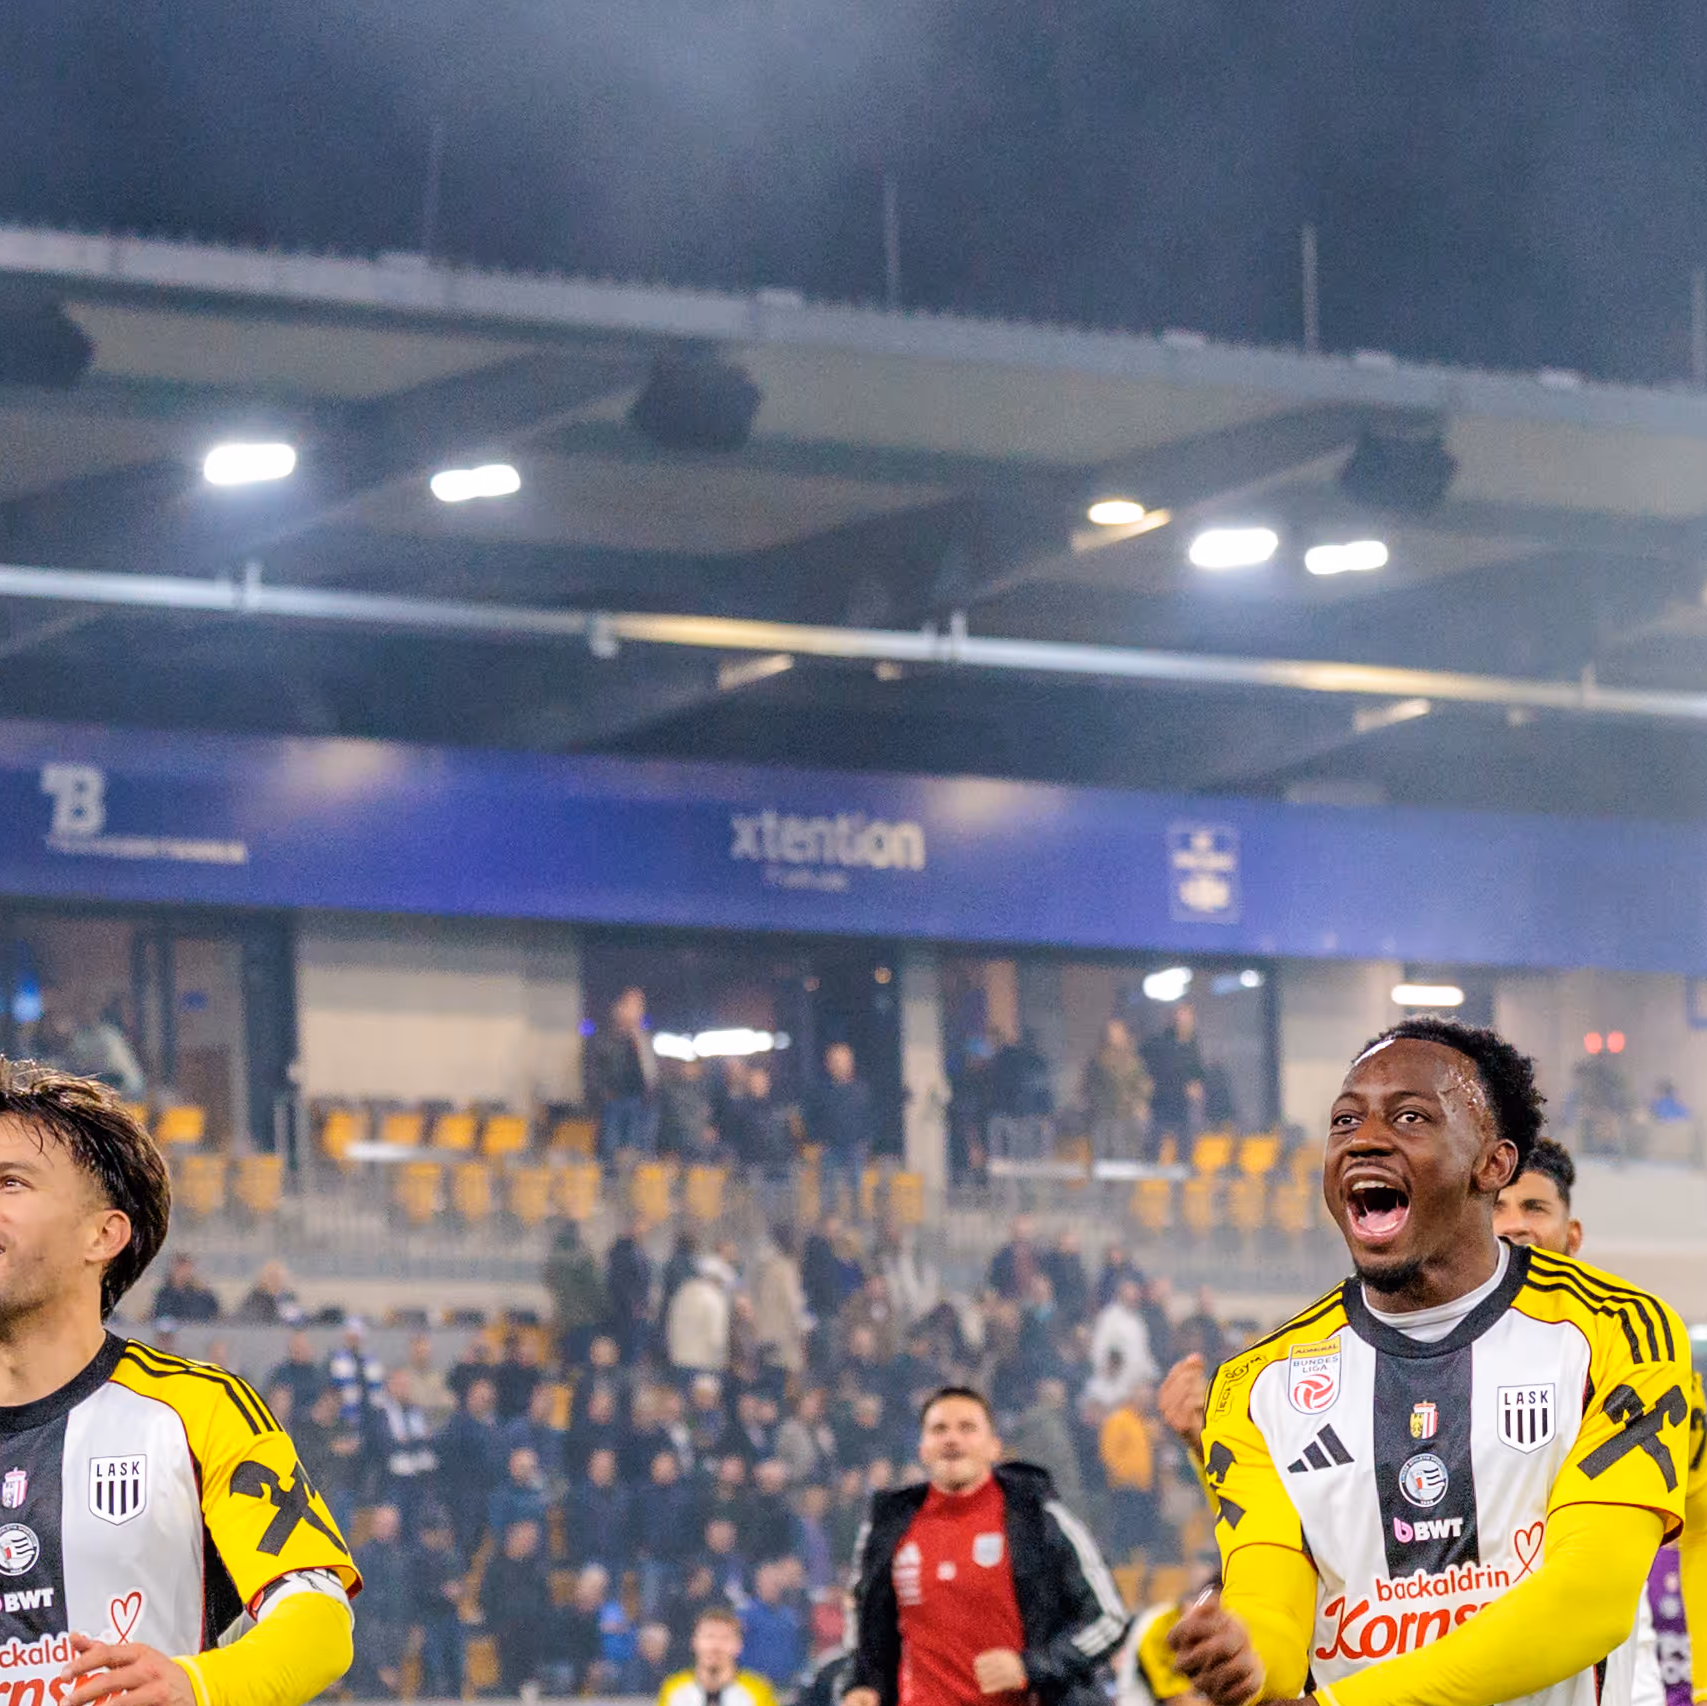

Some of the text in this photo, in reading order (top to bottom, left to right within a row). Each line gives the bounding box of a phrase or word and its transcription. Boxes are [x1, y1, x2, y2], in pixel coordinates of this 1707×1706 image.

[730, 810, 926, 870] xtention
[1293, 1355, 1339, 1367] BUNDES
[1504, 1389, 1549, 1406] LASK
[95, 1460, 141, 1477] LASK
[1413, 1517, 1463, 1541] BWT
[1376, 1564, 1509, 1602] backaldrin
[3, 1587, 54, 1612] BWT
